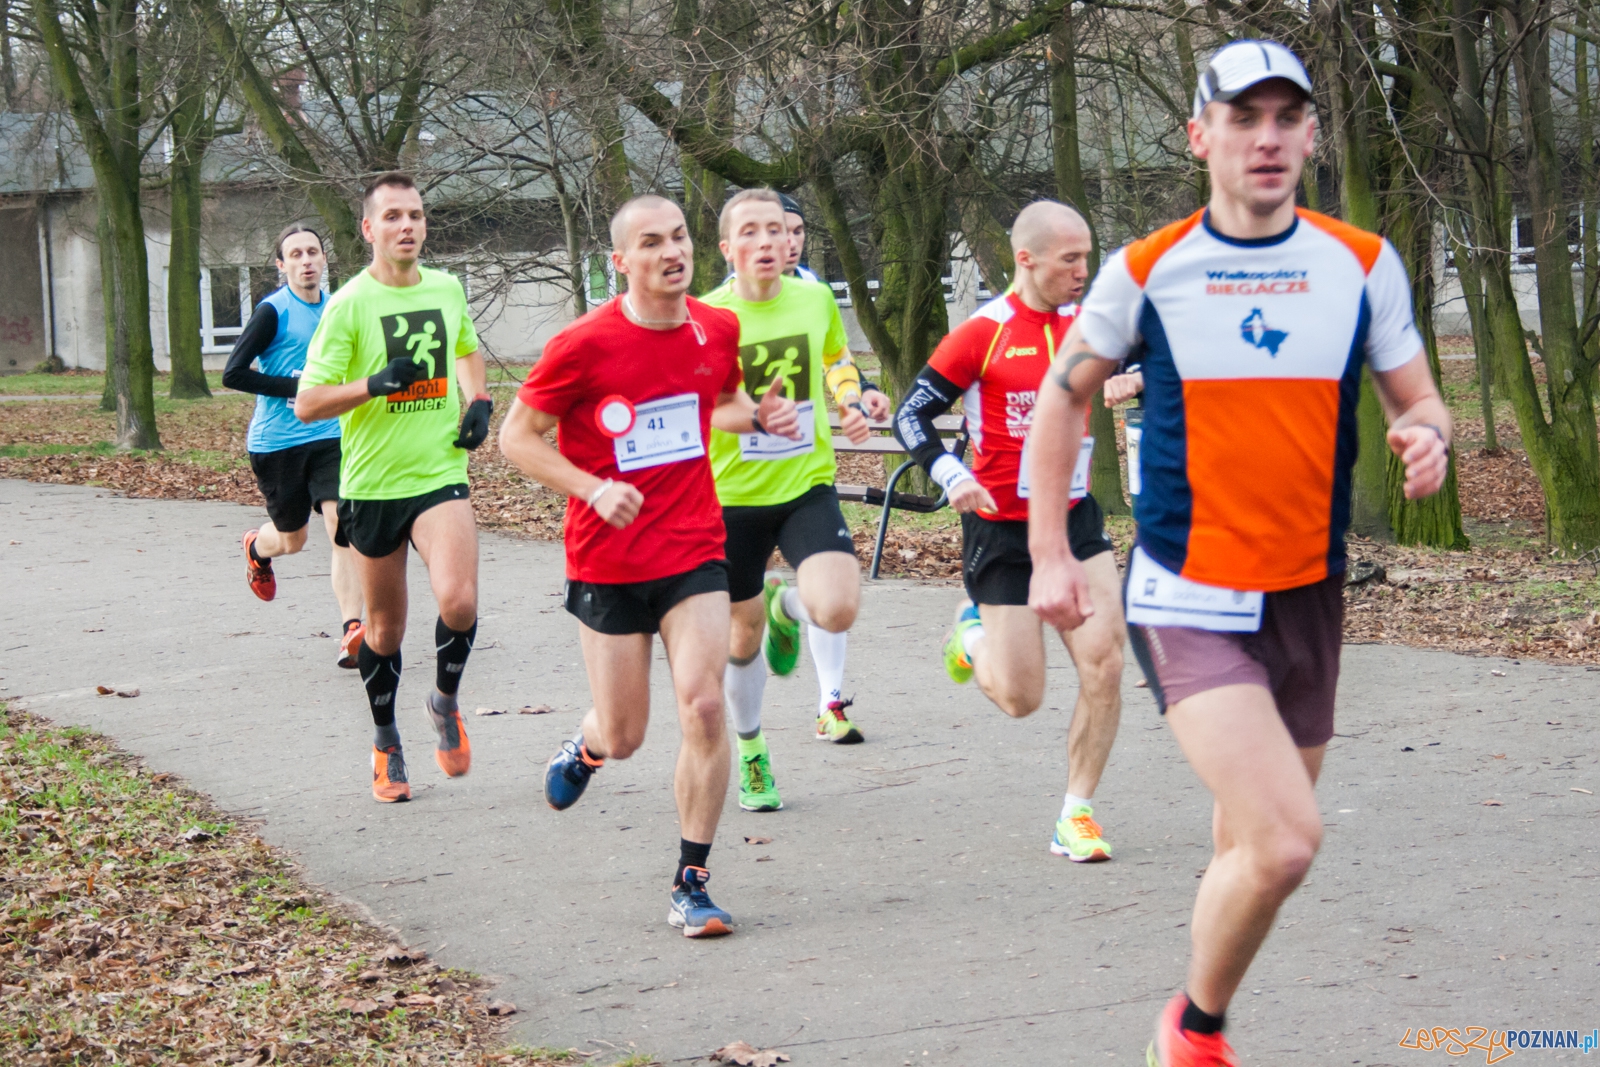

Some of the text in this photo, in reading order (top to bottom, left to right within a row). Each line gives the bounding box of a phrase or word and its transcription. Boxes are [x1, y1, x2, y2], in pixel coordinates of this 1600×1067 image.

[1206, 280, 1310, 295] BIEGACZE
[387, 397, 446, 413] runners
[647, 417, 665, 431] 41
